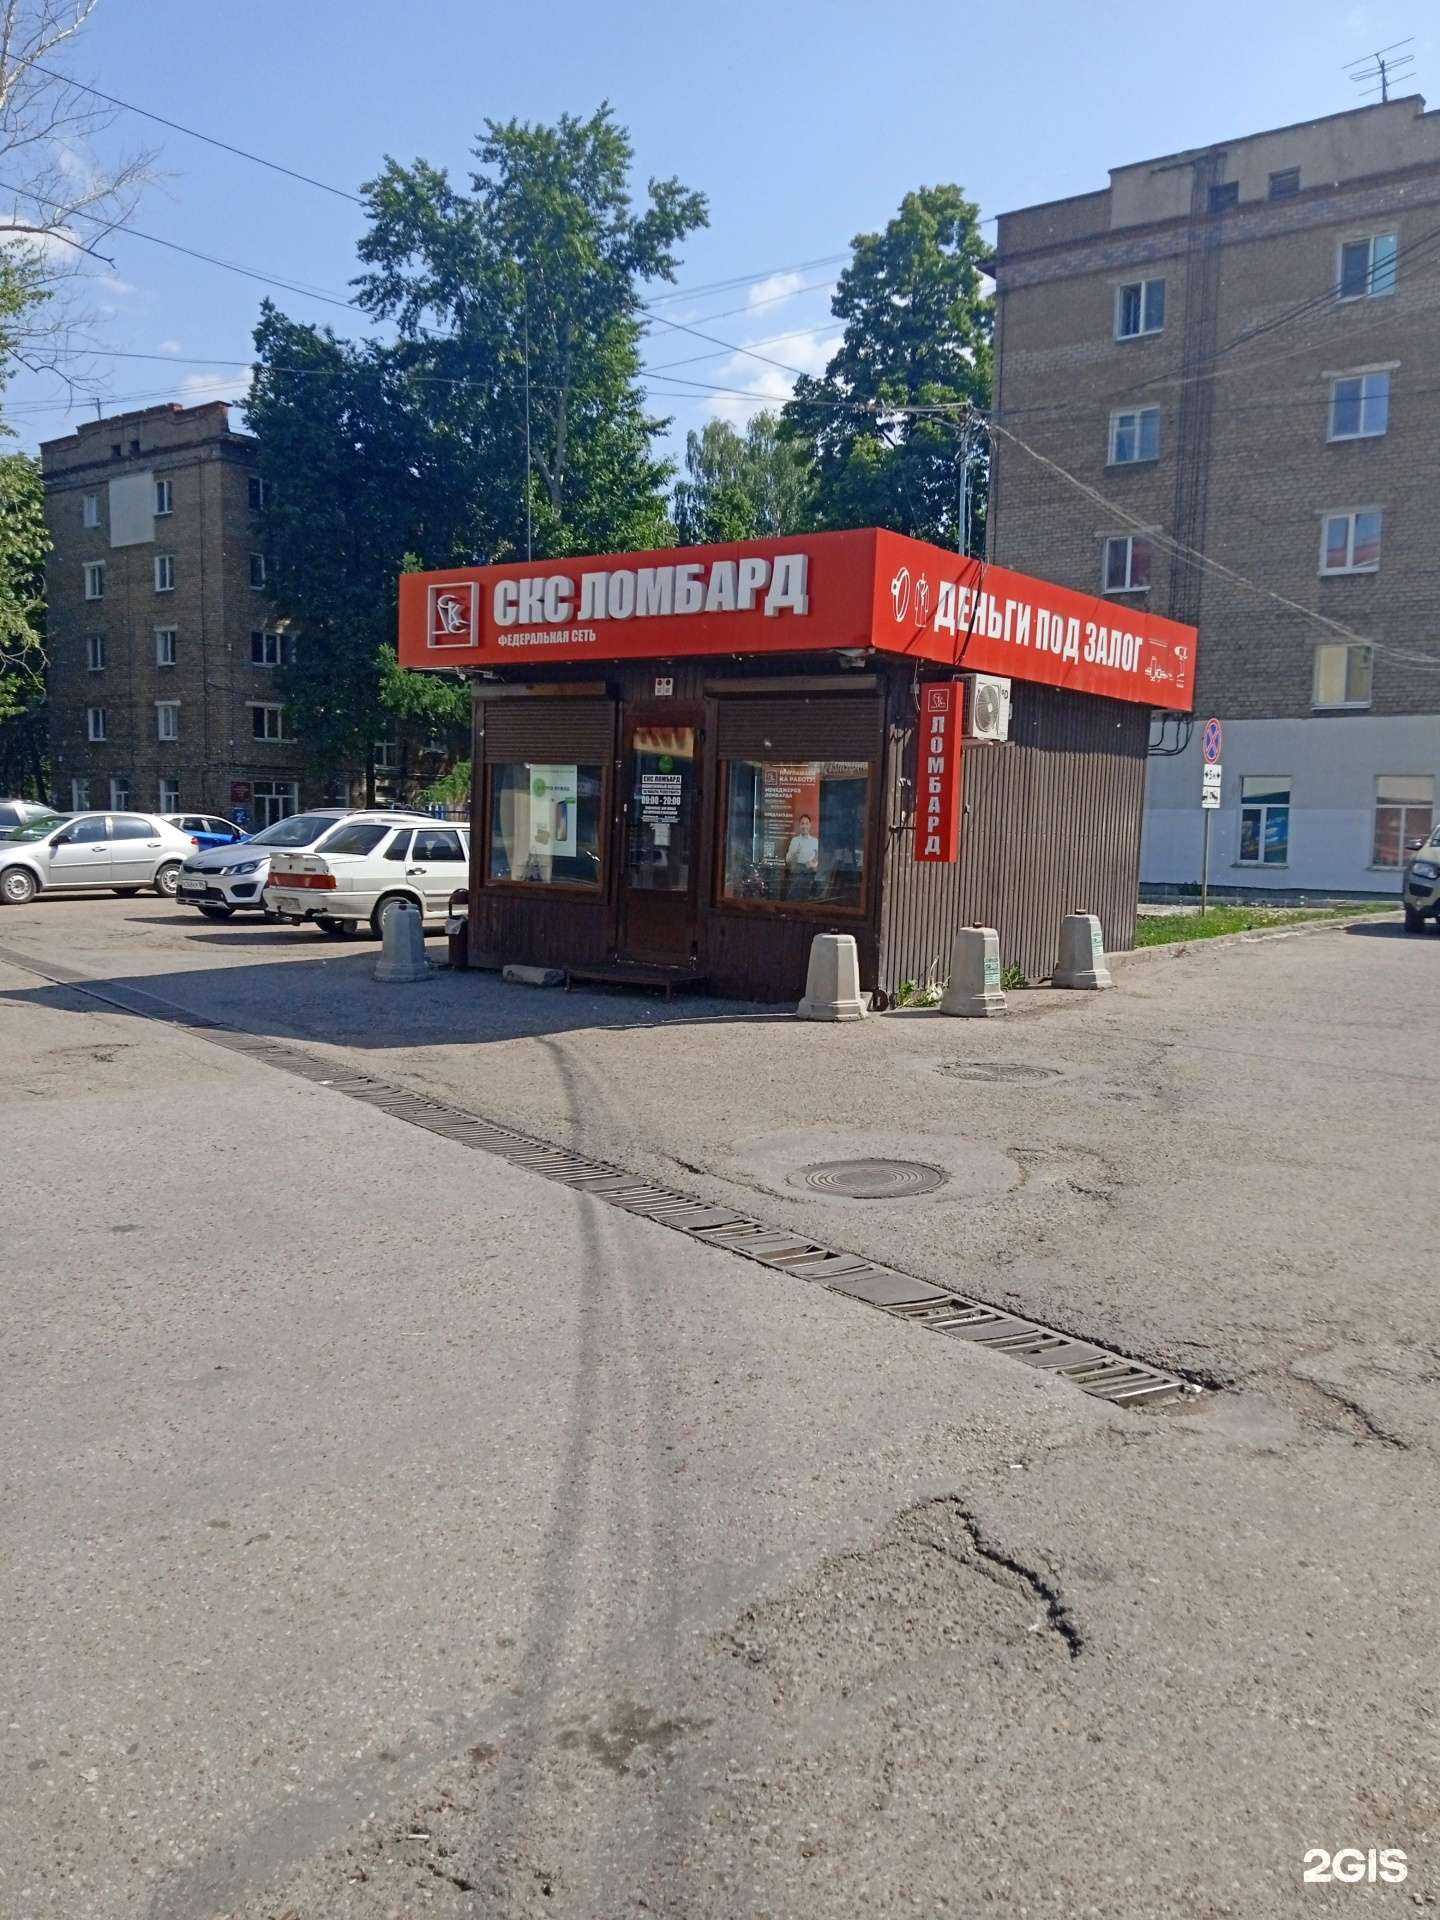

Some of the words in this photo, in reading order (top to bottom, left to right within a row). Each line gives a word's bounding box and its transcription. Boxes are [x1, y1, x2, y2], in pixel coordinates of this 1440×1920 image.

[494, 575, 575, 627] СКС
[577, 554, 808, 621] ЛОМБАРД
[934, 580, 1031, 647] ДЕНЬГИ
[1036, 608, 1081, 665] ПОД
[1084, 622, 1143, 673] ЗАЛОГ
[498, 631, 569, 646] ФЕДЕРАЛЬНАЯ
[572, 629, 597, 642] СЕТЬ
[925, 716, 945, 855] ЛОМБАРД
